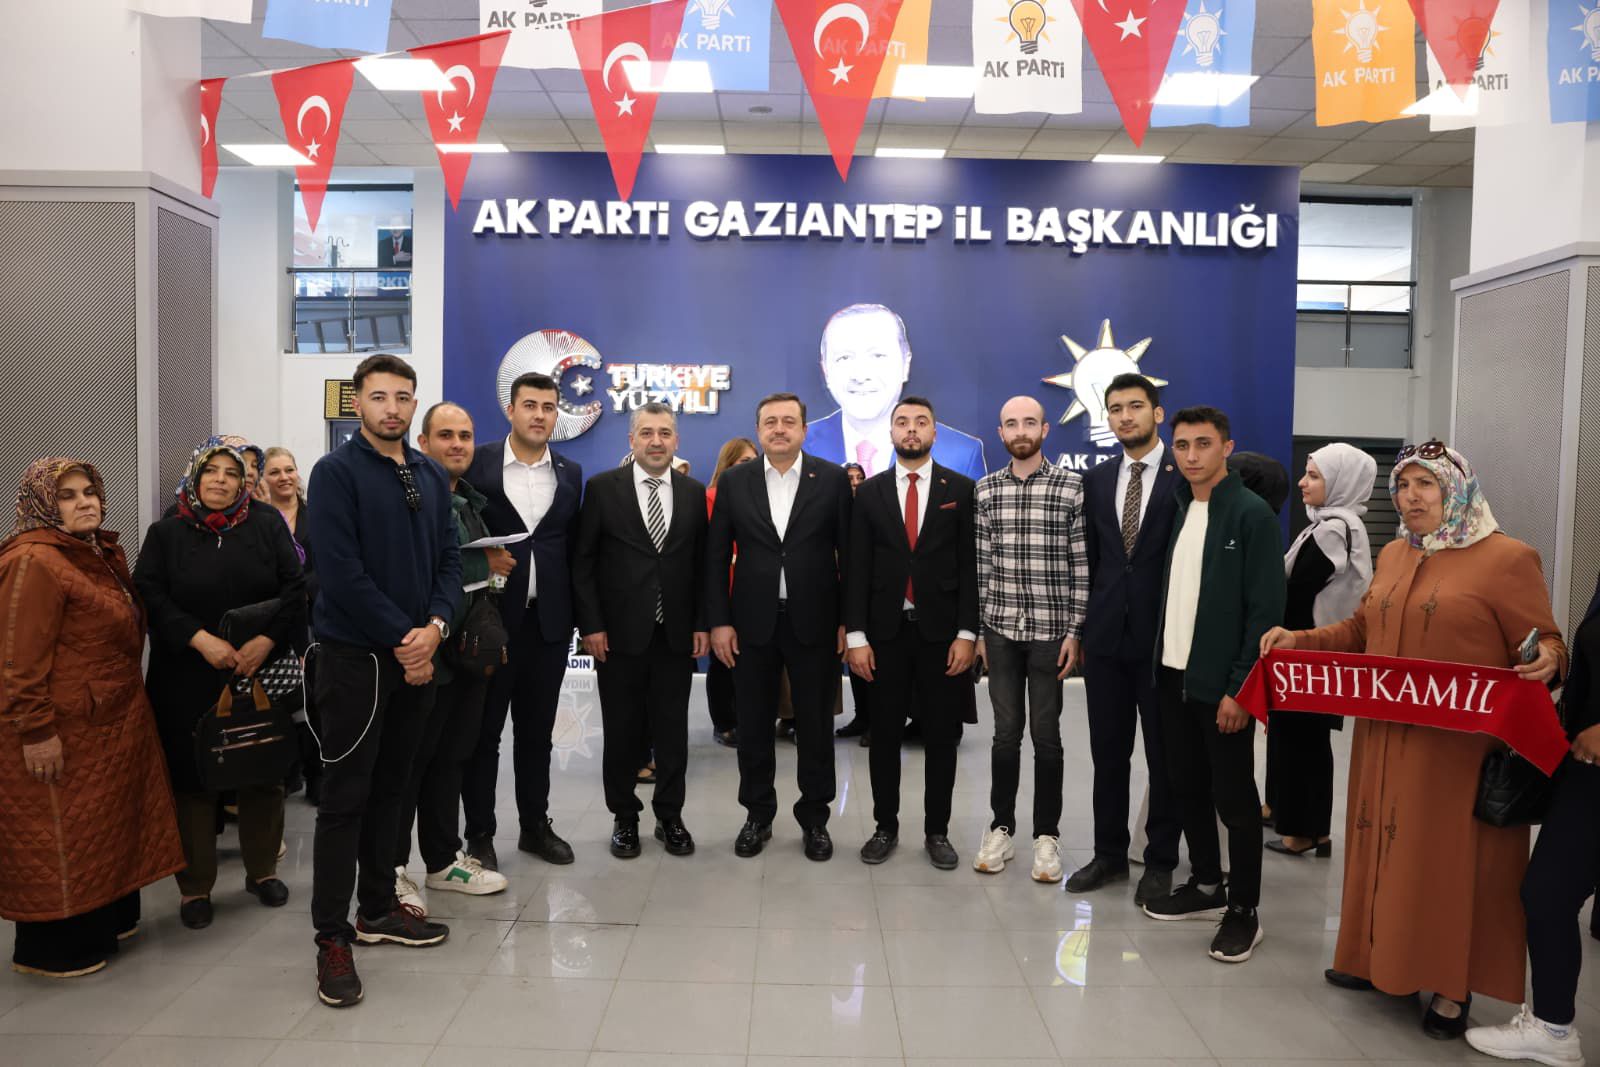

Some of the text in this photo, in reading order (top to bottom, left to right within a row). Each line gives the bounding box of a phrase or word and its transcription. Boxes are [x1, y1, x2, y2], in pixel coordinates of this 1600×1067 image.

[487, 11, 516, 28] AK
[983, 60, 1009, 78] AK
[1323, 69, 1347, 87] AK
[1559, 67, 1583, 84] AK
[471, 198, 539, 234] AK
[1006, 203, 1278, 254] BAŞKANLIĞI
[1060, 454, 1117, 470] AK P
[1272, 660, 1500, 714] ŞEHİTKAMİL
